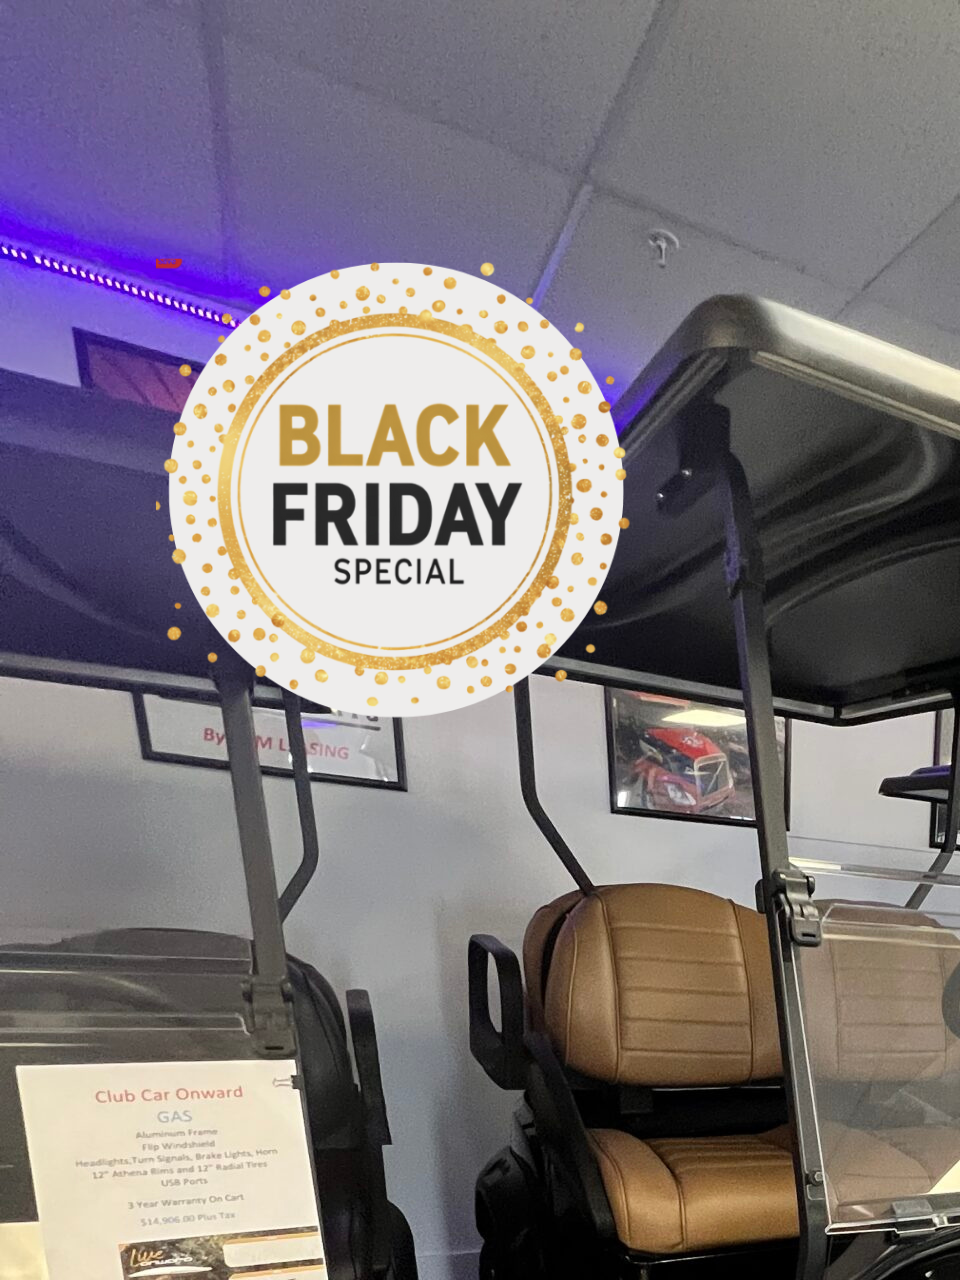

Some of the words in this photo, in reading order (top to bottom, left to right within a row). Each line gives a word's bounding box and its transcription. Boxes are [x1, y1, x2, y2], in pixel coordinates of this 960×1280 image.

[203, 727, 225, 746] By
[279, 737, 350, 760] LSING
[95, 1089, 136, 1104] Club
[141, 1088, 171, 1102] Car
[175, 1085, 243, 1101] Onward
[157, 1109, 193, 1123] GAS
[187, 1128, 218, 1136] Frame
[142, 1143, 160, 1152] Flip
[162, 1140, 216, 1150] Windshield
[195, 1152, 222, 1161] Brake
[255, 1148, 278, 1156] Horn
[112, 1169, 148, 1178] Athena
[176, 1165, 195, 1174] and
[216, 1162, 244, 1171] Radial
[246, 1161, 268, 1169] Tires
[161, 1178, 181, 1187] USB
[183, 1178, 208, 1186] Ports
[127, 1201, 134, 1210] 3
[136, 1200, 159, 1209] Year
[161, 1196, 207, 1207] Warranty
[208, 1195, 223, 1203] On
[224, 1193, 245, 1202] Cart
[197, 1213, 217, 1222] Plus
[219, 1211, 236, 1219] Tax
